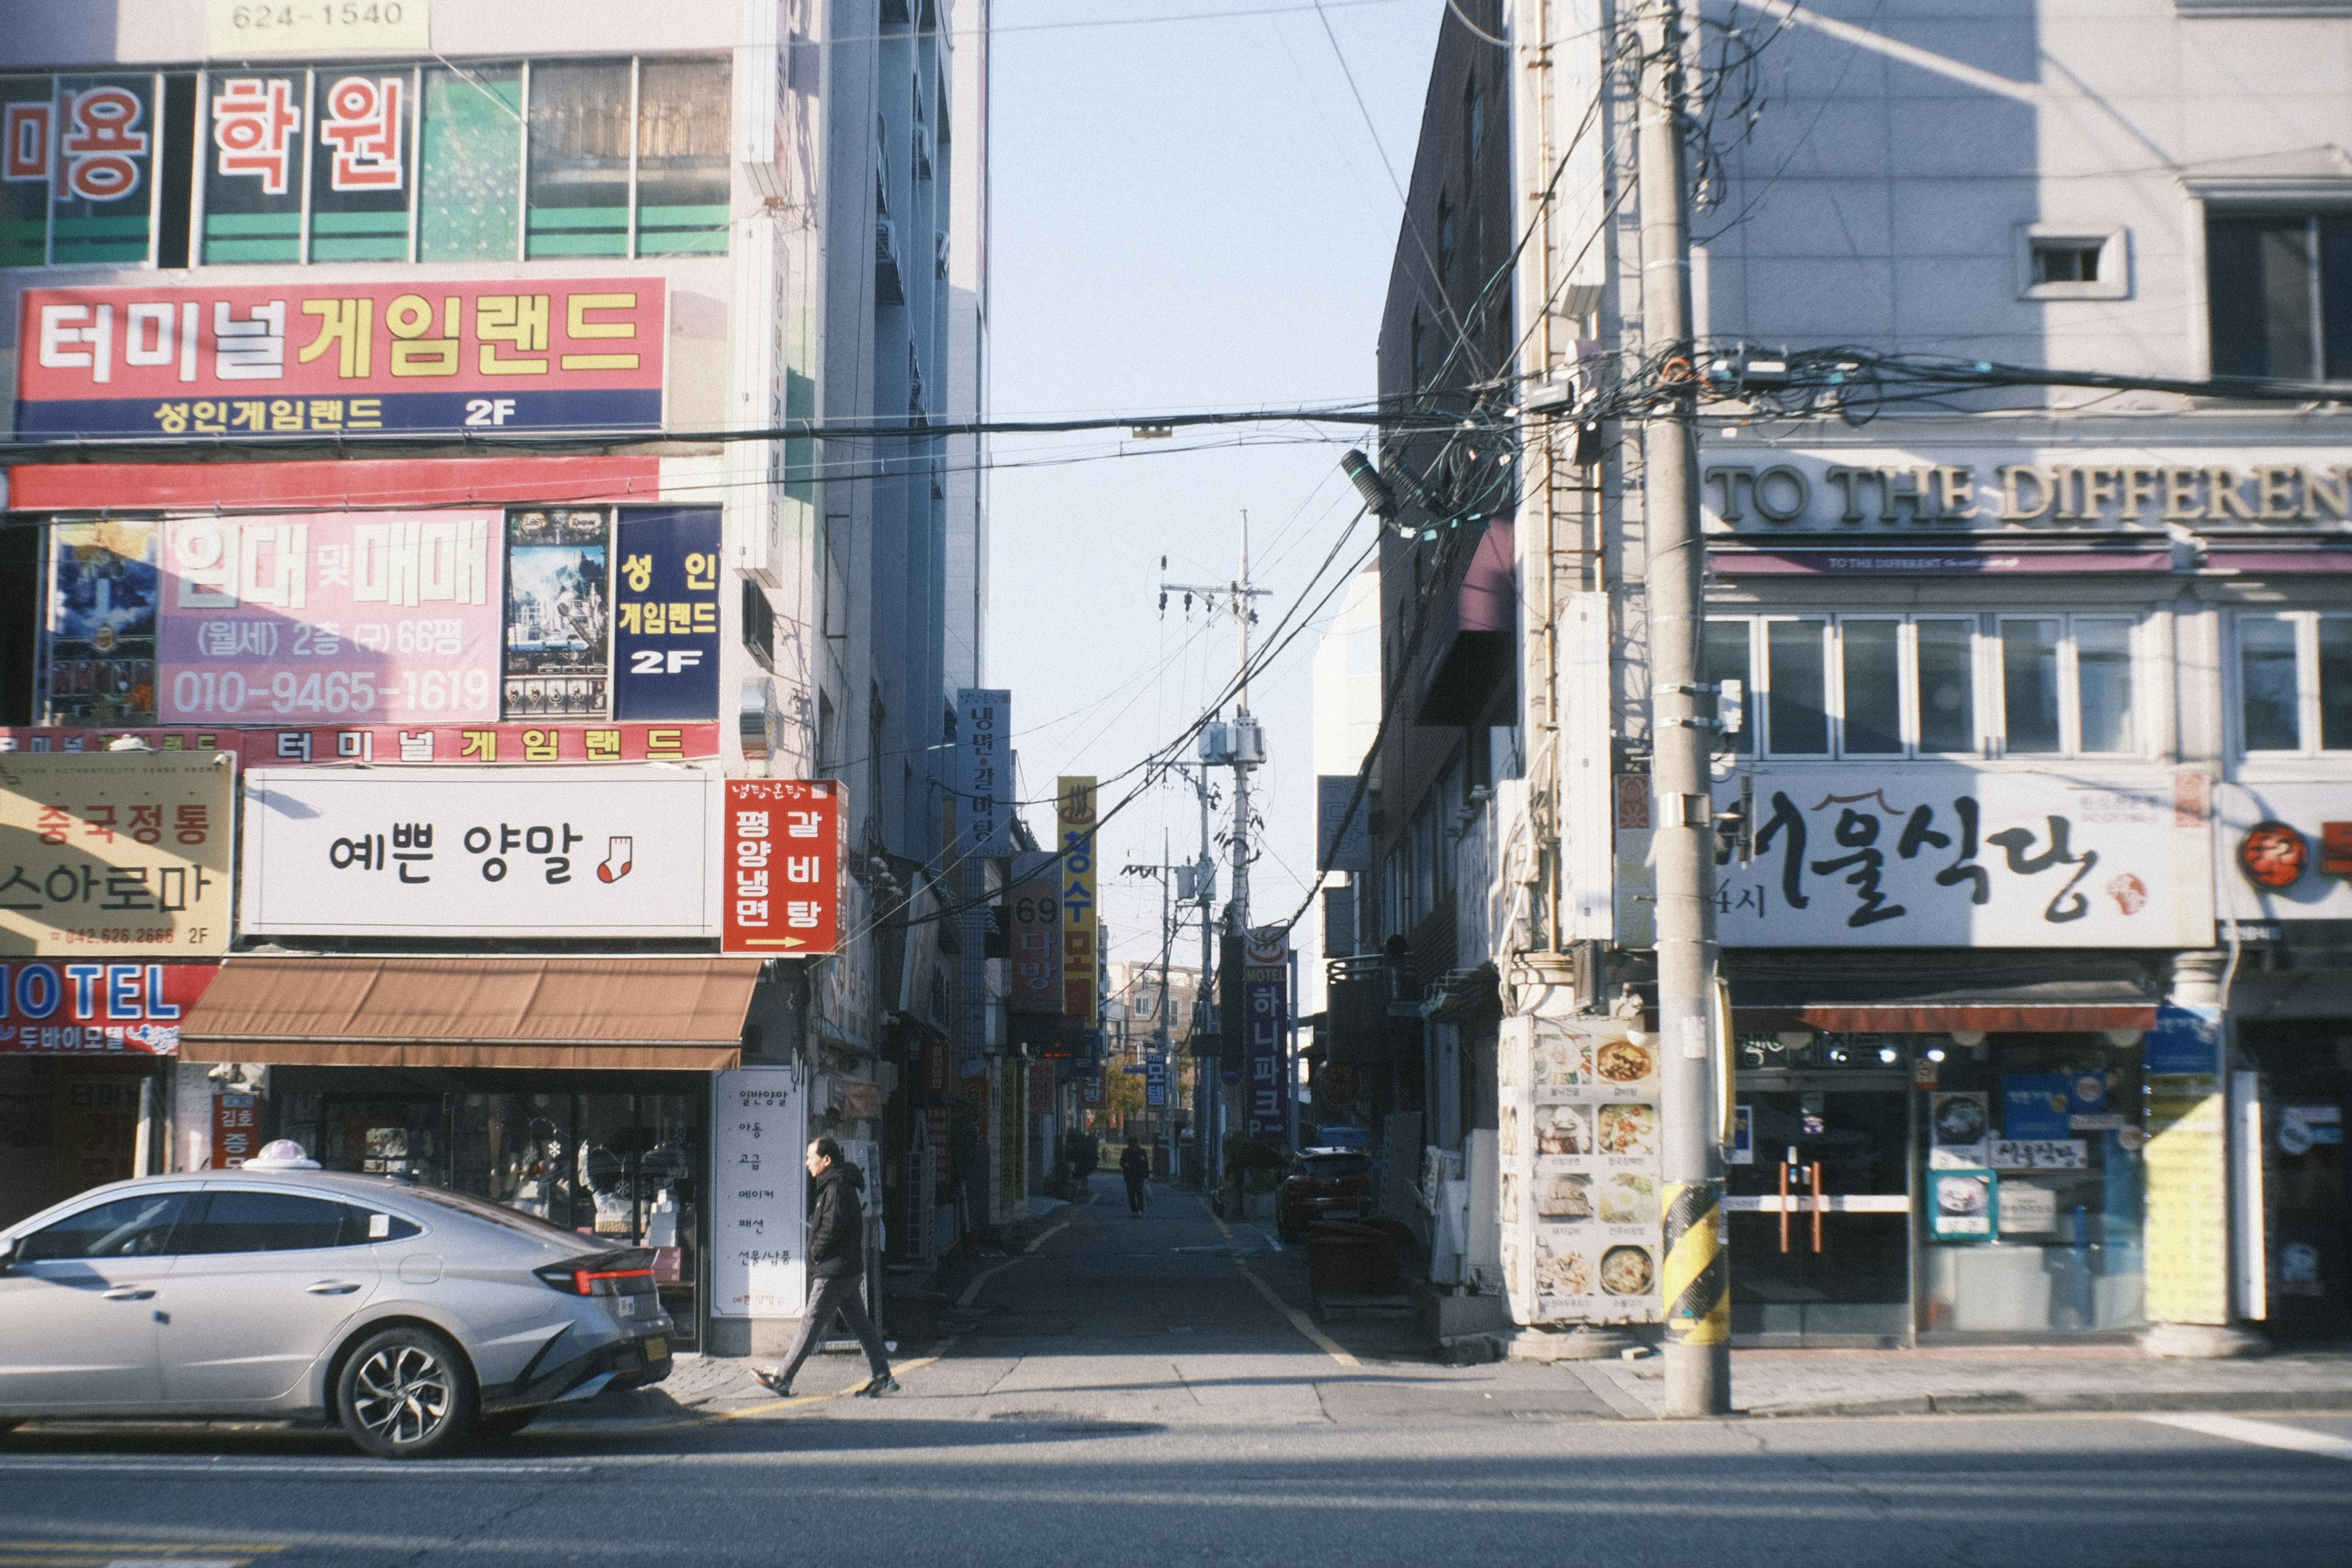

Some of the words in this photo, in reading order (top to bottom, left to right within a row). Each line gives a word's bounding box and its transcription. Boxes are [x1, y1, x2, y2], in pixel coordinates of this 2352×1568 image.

[232, 1, 404, 29] 624-1540
[154, 399, 383, 434] 성인게임랜드
[464, 399, 516, 426] 2F
[1706, 464, 1811, 522] TO
[1826, 464, 1981, 522] THE
[176, 518, 308, 611] 임대
[353, 520, 489, 608] 매매
[619, 602, 717, 635] 게임랜드
[630, 650, 703, 674] 2F
[174, 669, 490, 715] 010-9465-1619
[37, 804, 210, 848] 중국정통
[330, 823, 434, 883] 예쁜
[463, 823, 583, 884] 양말
[736, 811, 771, 927] 평양냉면
[787, 811, 823, 929] 갈비탕
[1016, 897, 1058, 924] 69
[189, 927, 209, 944] 2F
[20, 1026, 125, 1050] 두바이모텔
[739, 1090, 788, 1106] 일반양말
[739, 1122, 762, 1138] 아동
[739, 1154, 761, 1170] 고급
[739, 1190, 774, 1199] 메이커
[739, 1219, 764, 1234] 패션
